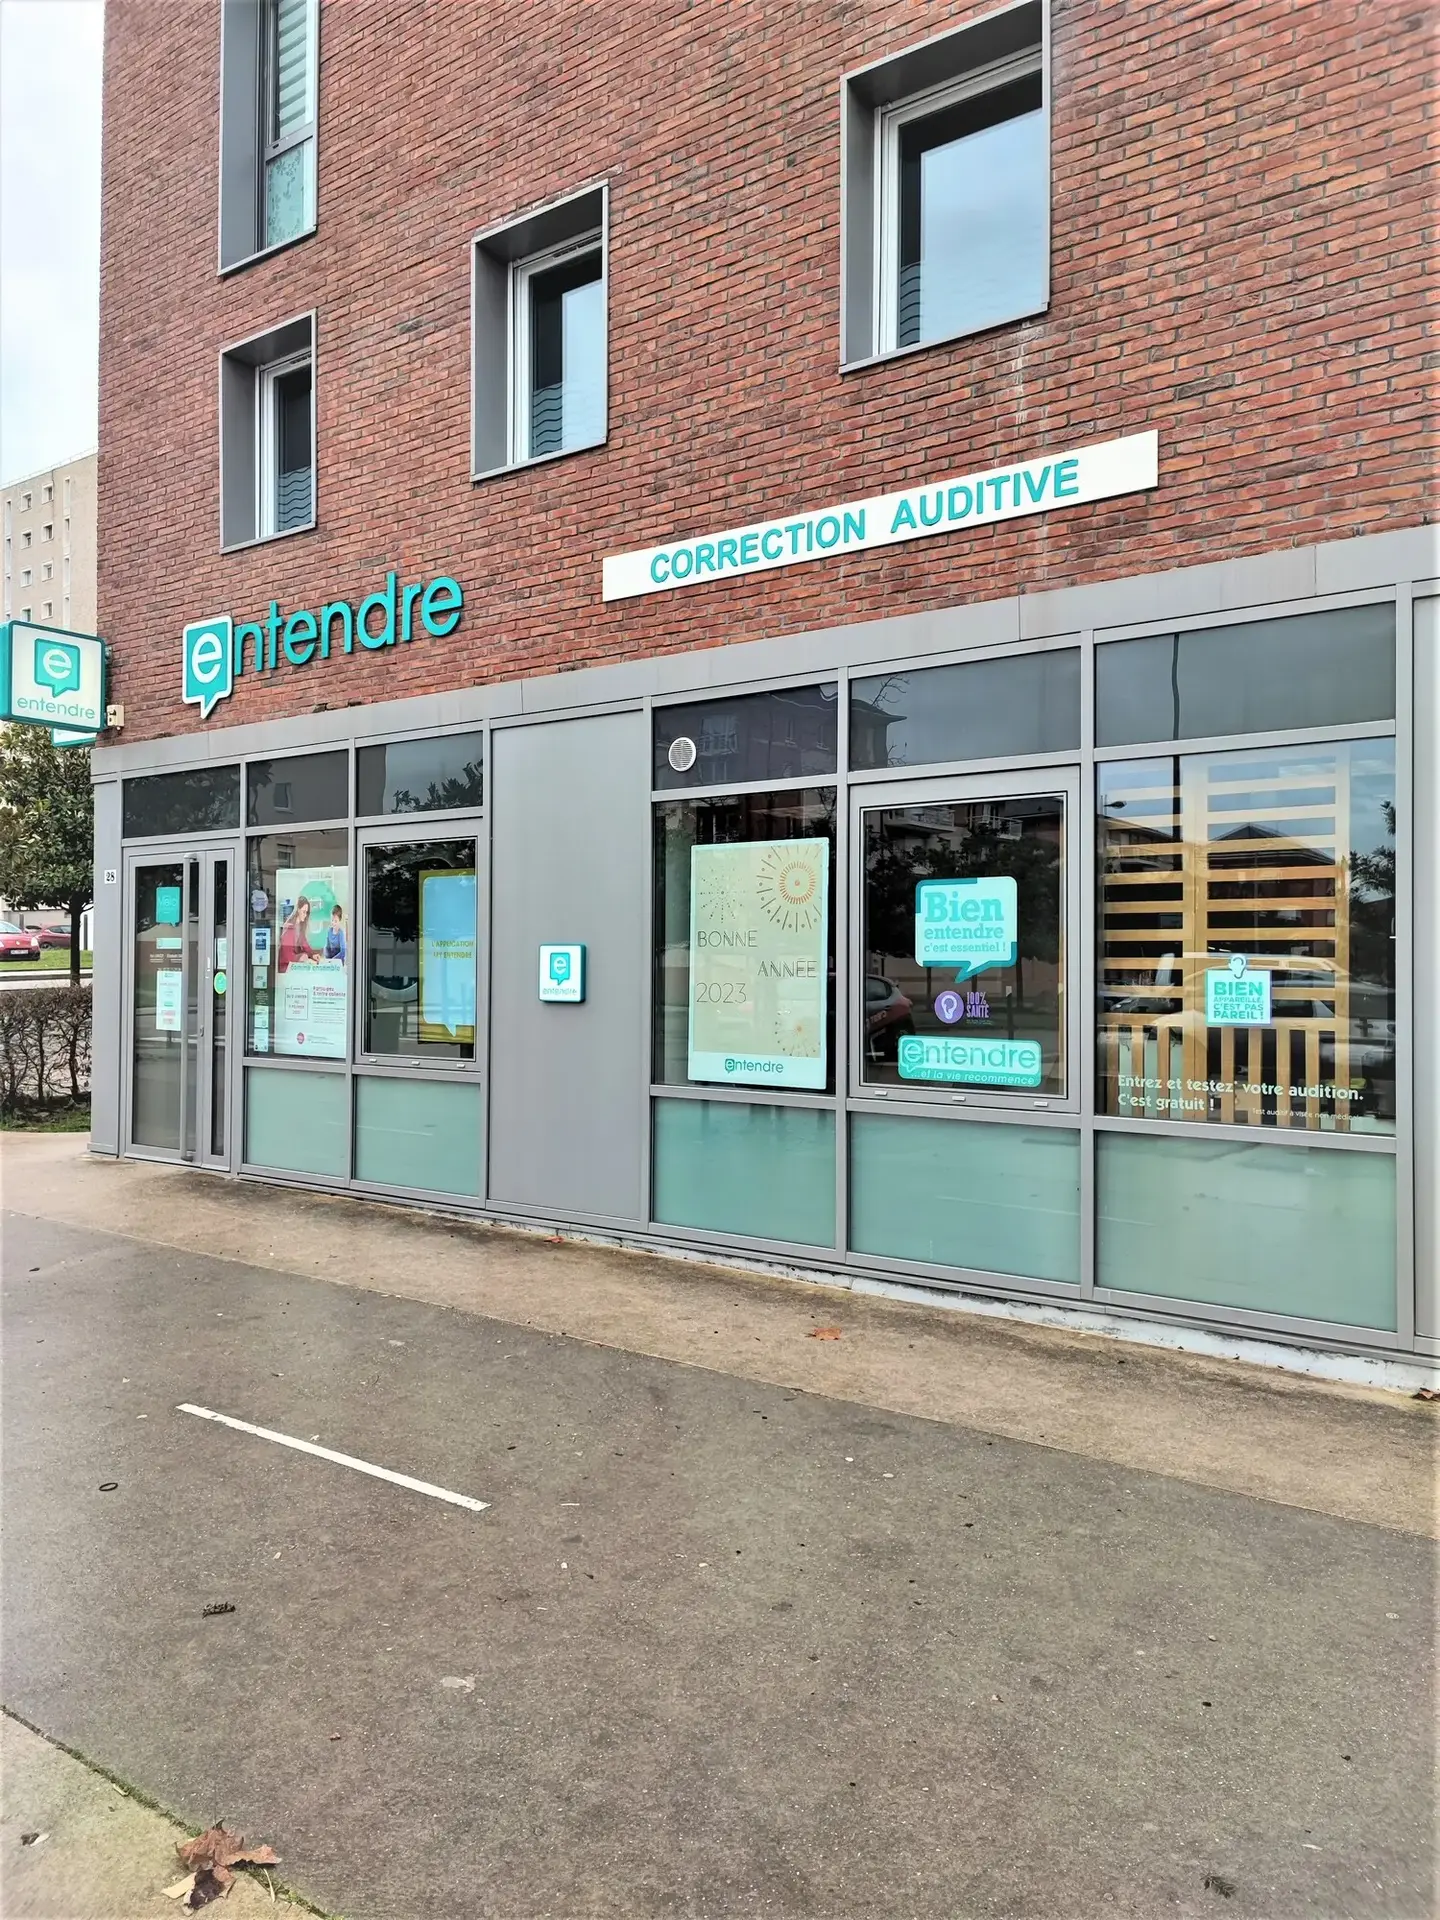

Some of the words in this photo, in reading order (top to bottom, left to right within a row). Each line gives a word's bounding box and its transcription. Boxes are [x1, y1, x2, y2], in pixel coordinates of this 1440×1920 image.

[650, 508, 866, 583] CORRECTION
[890, 459, 1080, 533] AUDITIVE
[188, 571, 464, 685] entendre
[43, 648, 73, 679] e
[17, 697, 95, 719] entendre
[105, 871, 116, 882] 28
[924, 891, 1005, 922] Bien
[697, 930, 759, 948] BONNE
[923, 923, 1005, 940] entendre
[923, 943, 949, 953] c'est
[950, 942, 1000, 952] essentiel
[757, 958, 818, 978] ANNÉE
[695, 982, 747, 1004] 2023
[1213, 981, 1264, 996] BIEN
[966, 991, 988, 1005] 100%
[1213, 1003, 1241, 1011] C'EST
[1244, 1003, 1264, 1011] PAS
[966, 1004, 990, 1018] SANTÉ
[1213, 1010, 1258, 1020] PAREIL
[902, 1040, 1037, 1070] entendre
[725, 1057, 784, 1074] entendre
[933, 1071, 944, 1080] la
[946, 1071, 961, 1081] vie
[964, 1073, 1035, 1085] recommence
[1118, 1075, 1163, 1089] Entrez
[1166, 1078, 1182, 1090] et
[1242, 1082, 1284, 1096] votre
[1288, 1084, 1364, 1100] audition.
[1118, 1093, 1152, 1107] C'est
[1156, 1097, 1205, 1111] gratuit
